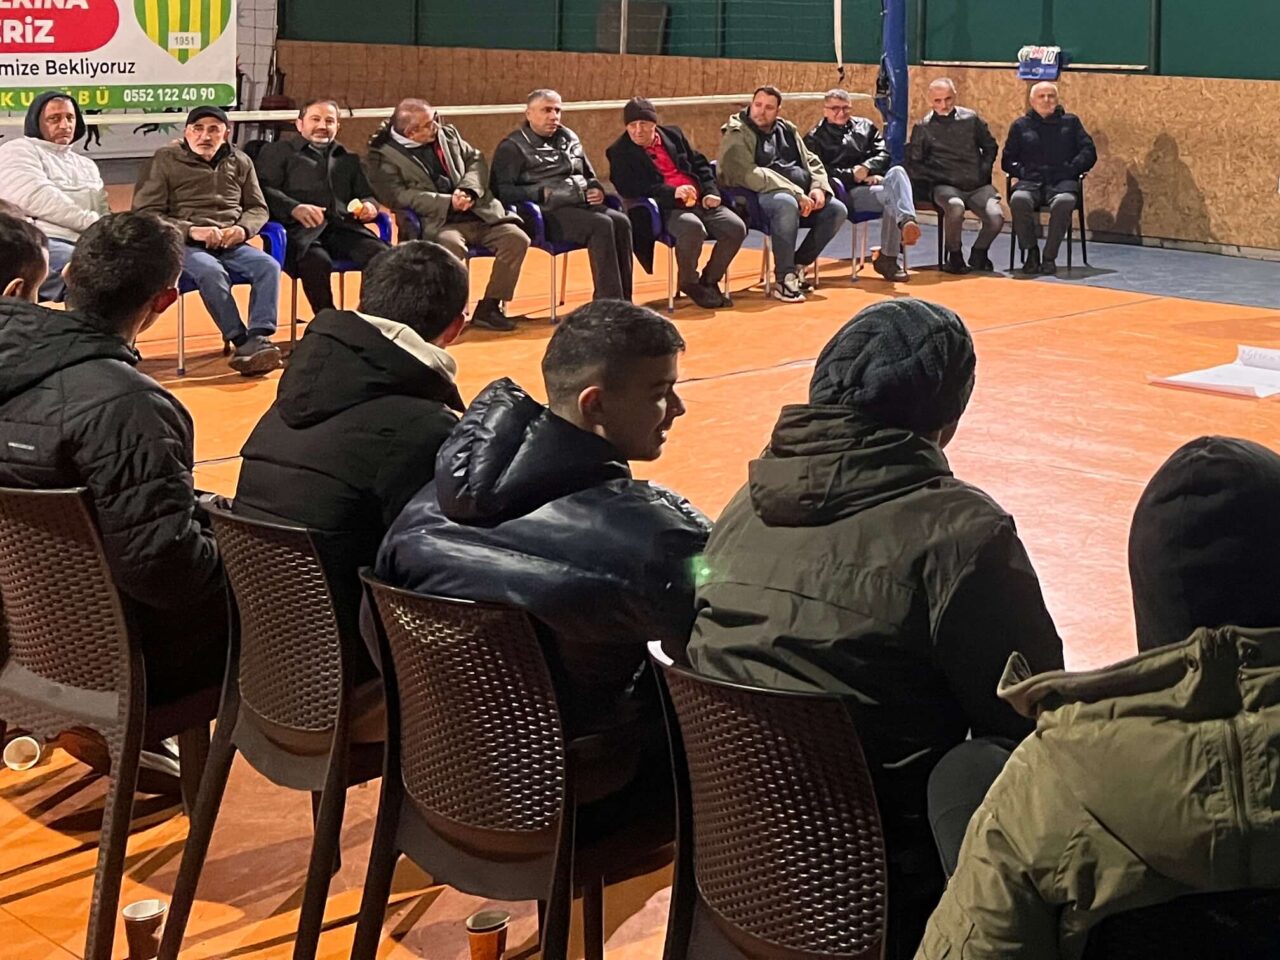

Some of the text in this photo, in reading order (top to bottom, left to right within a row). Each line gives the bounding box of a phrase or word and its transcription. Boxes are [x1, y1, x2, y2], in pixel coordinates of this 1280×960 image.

[174, 36, 195, 47] 1951
[45, 58, 136, 79] Bekliyoruz
[123, 89, 154, 103] 0552
[157, 89, 180, 102] 122
[182, 87, 197, 101] 40
[200, 87, 216, 100] 90
